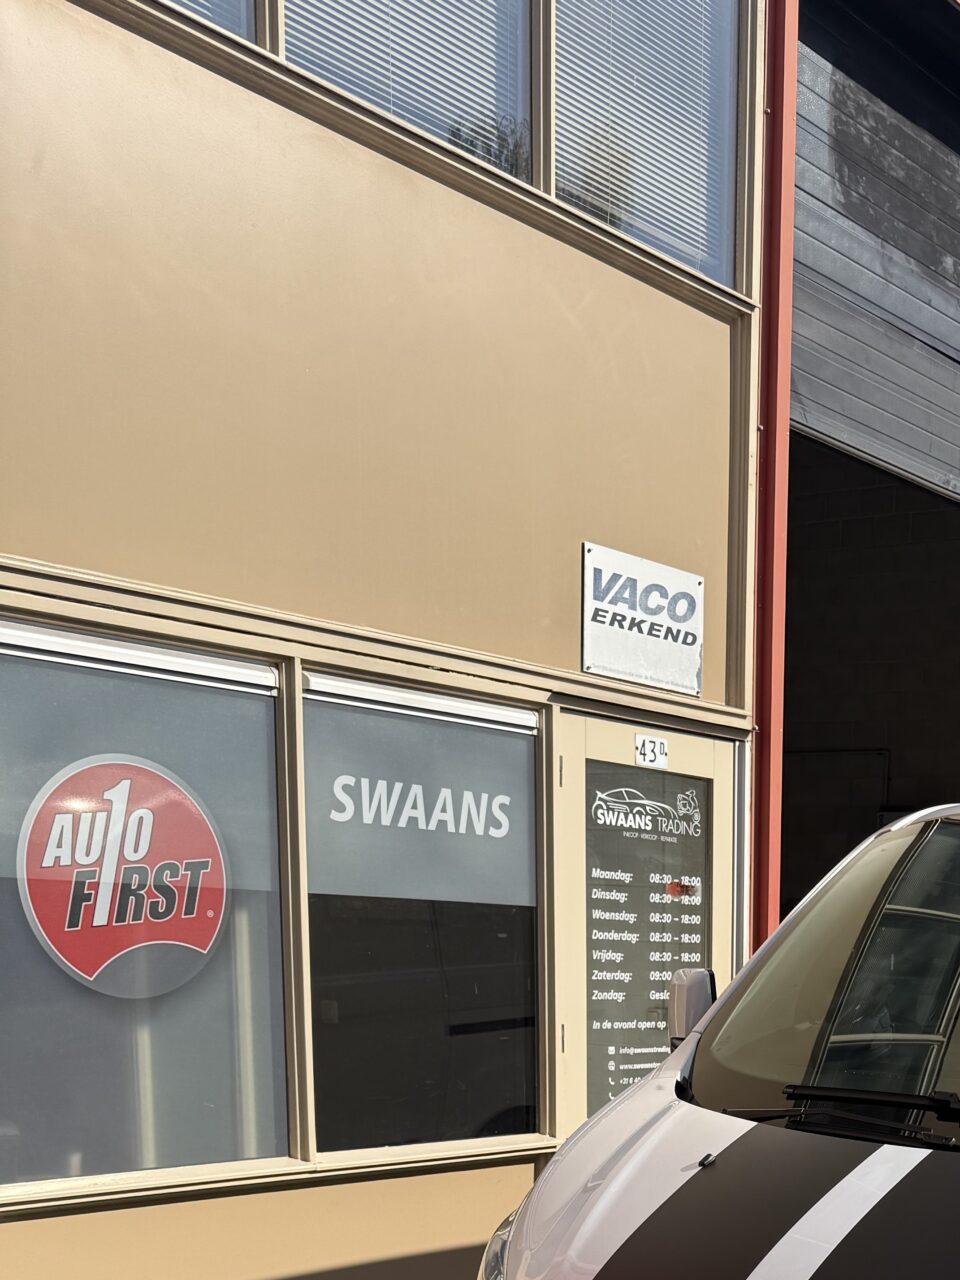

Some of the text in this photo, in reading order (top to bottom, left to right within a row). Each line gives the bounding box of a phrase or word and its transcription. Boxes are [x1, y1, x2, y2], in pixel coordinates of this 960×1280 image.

[593, 567, 697, 623] VACO
[591, 607, 697, 647] ERKEND
[330, 774, 511, 838] SWAANS
[597, 809, 701, 837] SWAANS TRADING
[592, 868, 633, 883] Maandag:
[650, 873, 672, 884] 08:30
[681, 876, 701, 886] 18:00
[65, 858, 211, 931] FIRST
[592, 888, 628, 903] Dinsdag:
[650, 893, 672, 904] 08:30
[681, 895, 701, 906] 18:00
[592, 909, 637, 924] Woensdag:
[650, 912, 672, 923] 08:30
[681, 914, 701, 925] 18:00
[592, 929, 640, 944] Donderdag:
[650, 932, 672, 943] 08:30
[681, 933, 701, 943] 18:00
[592, 950, 624, 963] Vrijdag:
[650, 952, 672, 962] 08:30
[681, 952, 701, 962] 18:00
[592, 970, 672, 983] Zaterdag: 09:00
[592, 990, 626, 1002] Zondag:
[592, 1020, 666, 1031] In de avond open op
